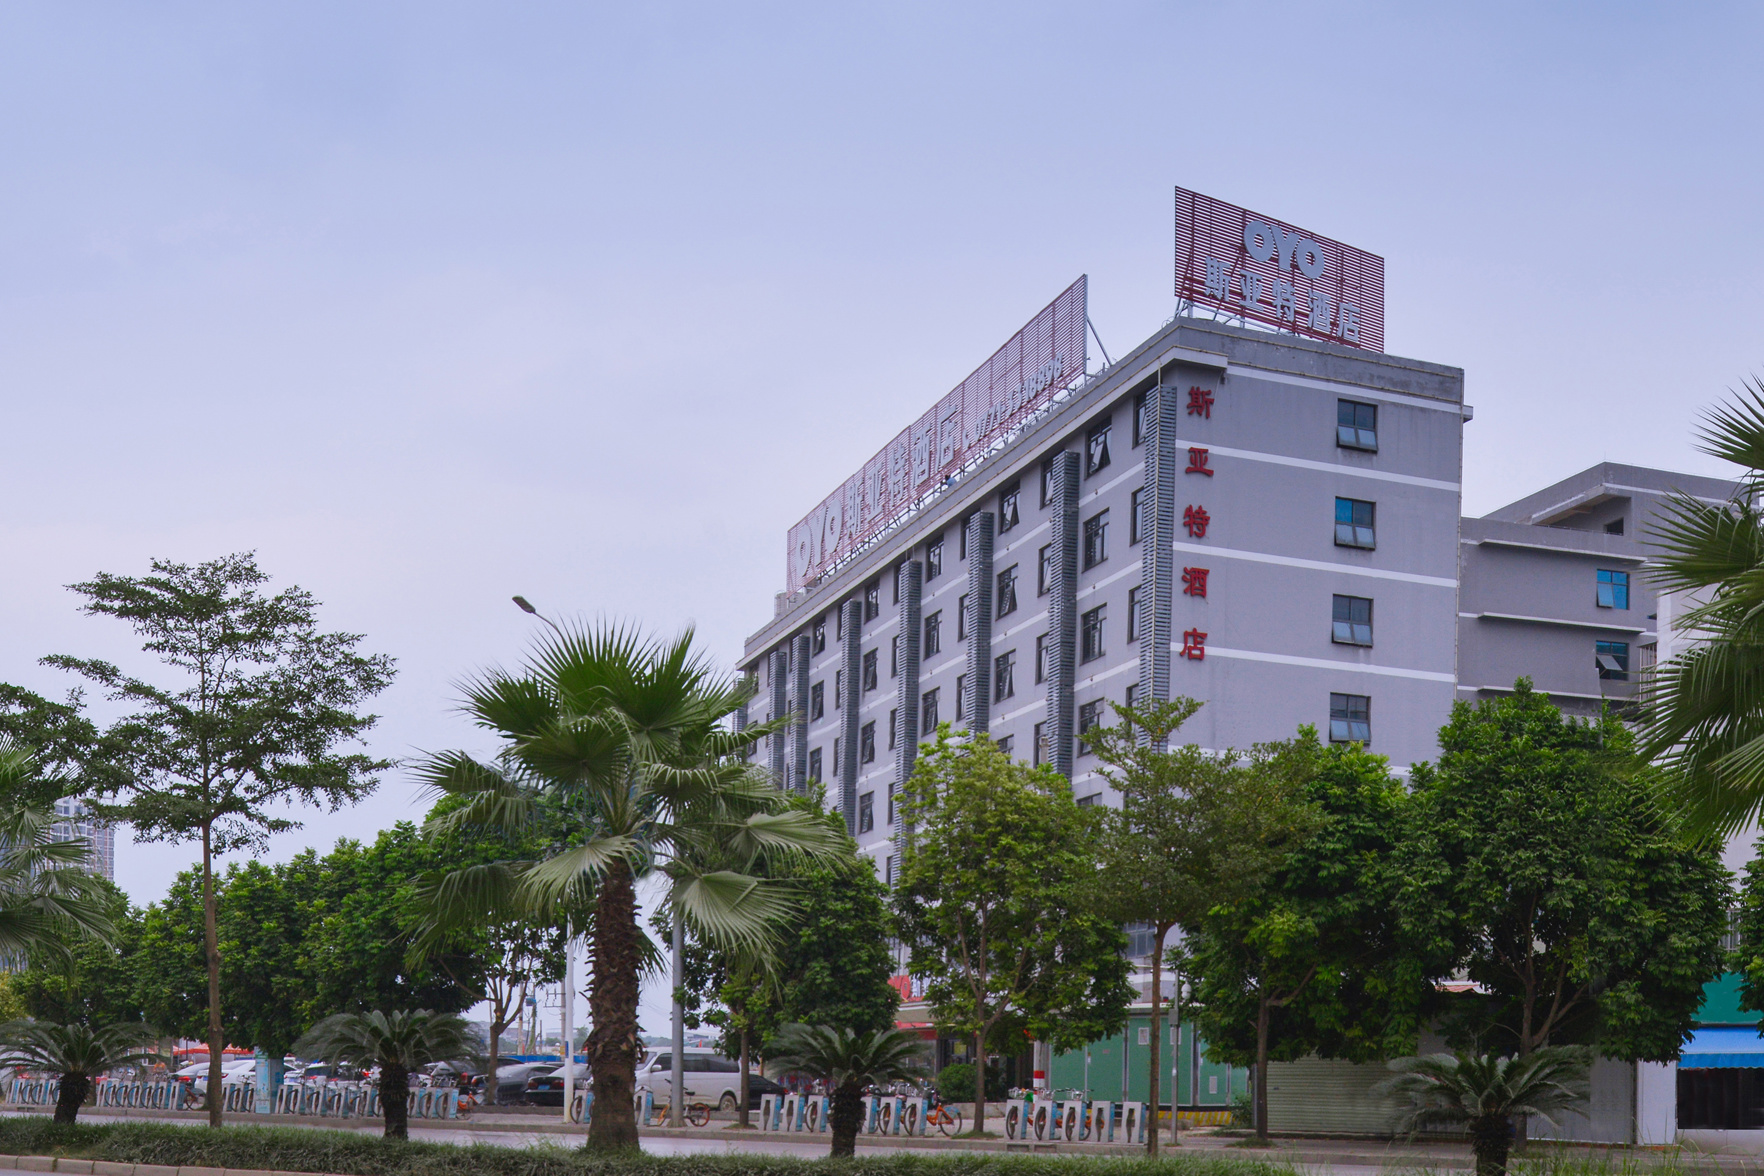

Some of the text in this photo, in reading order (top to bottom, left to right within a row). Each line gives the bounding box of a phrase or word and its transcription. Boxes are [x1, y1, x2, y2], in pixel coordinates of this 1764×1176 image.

[1203, 255, 1361, 342] 斯亚特酒店
[1243, 220, 1325, 279] OYO
[794, 498, 842, 577] OYO
[846, 405, 957, 539] 斯亚特酒店
[1180, 386, 1215, 661] 斯亚特酒店
